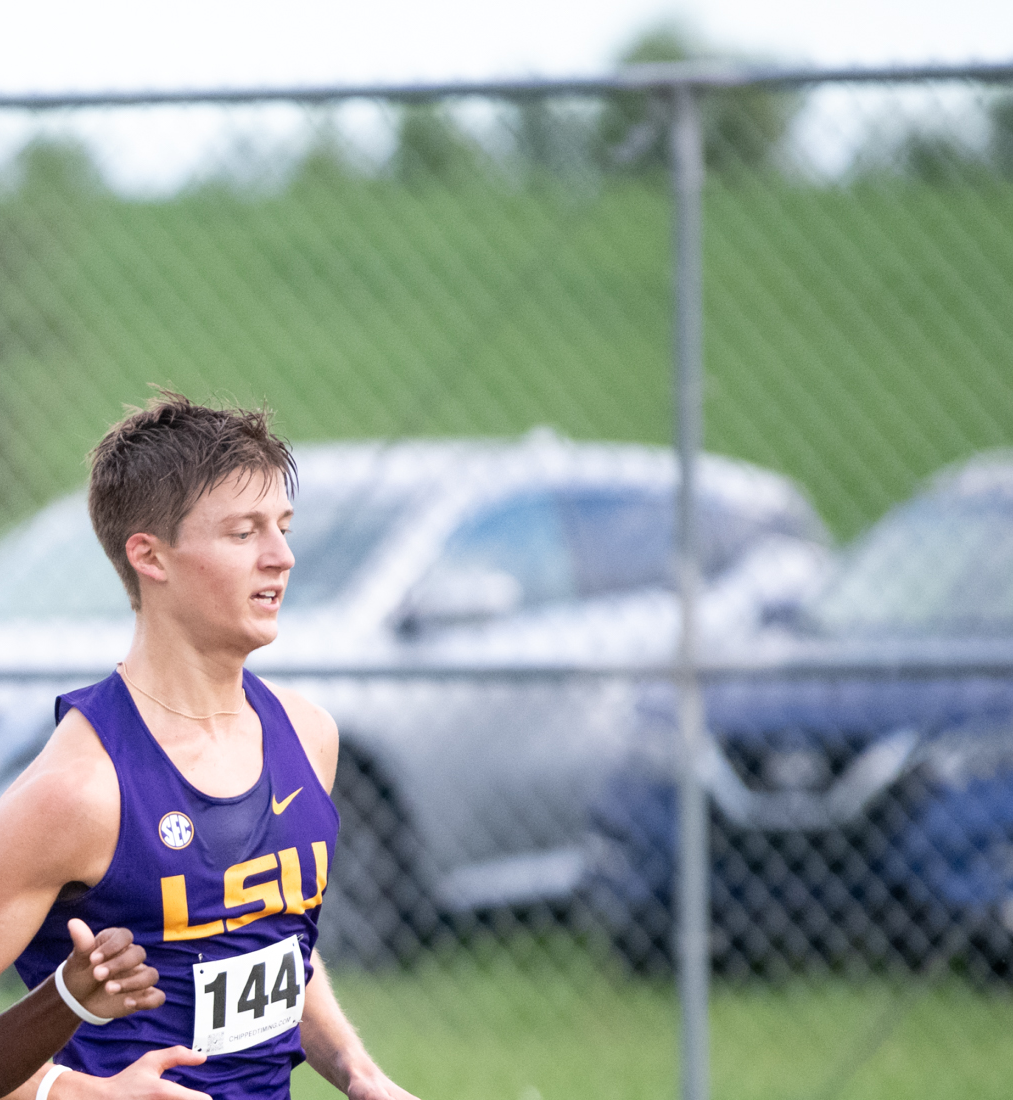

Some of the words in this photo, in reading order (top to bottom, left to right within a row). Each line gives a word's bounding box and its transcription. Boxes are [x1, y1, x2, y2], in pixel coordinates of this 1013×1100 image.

[160, 814, 191, 847] SEC
[160, 841, 328, 941] LSU
[204, 951, 301, 1030] 144
[228, 1016, 291, 1043] CHIPPEDTIMING.COM
